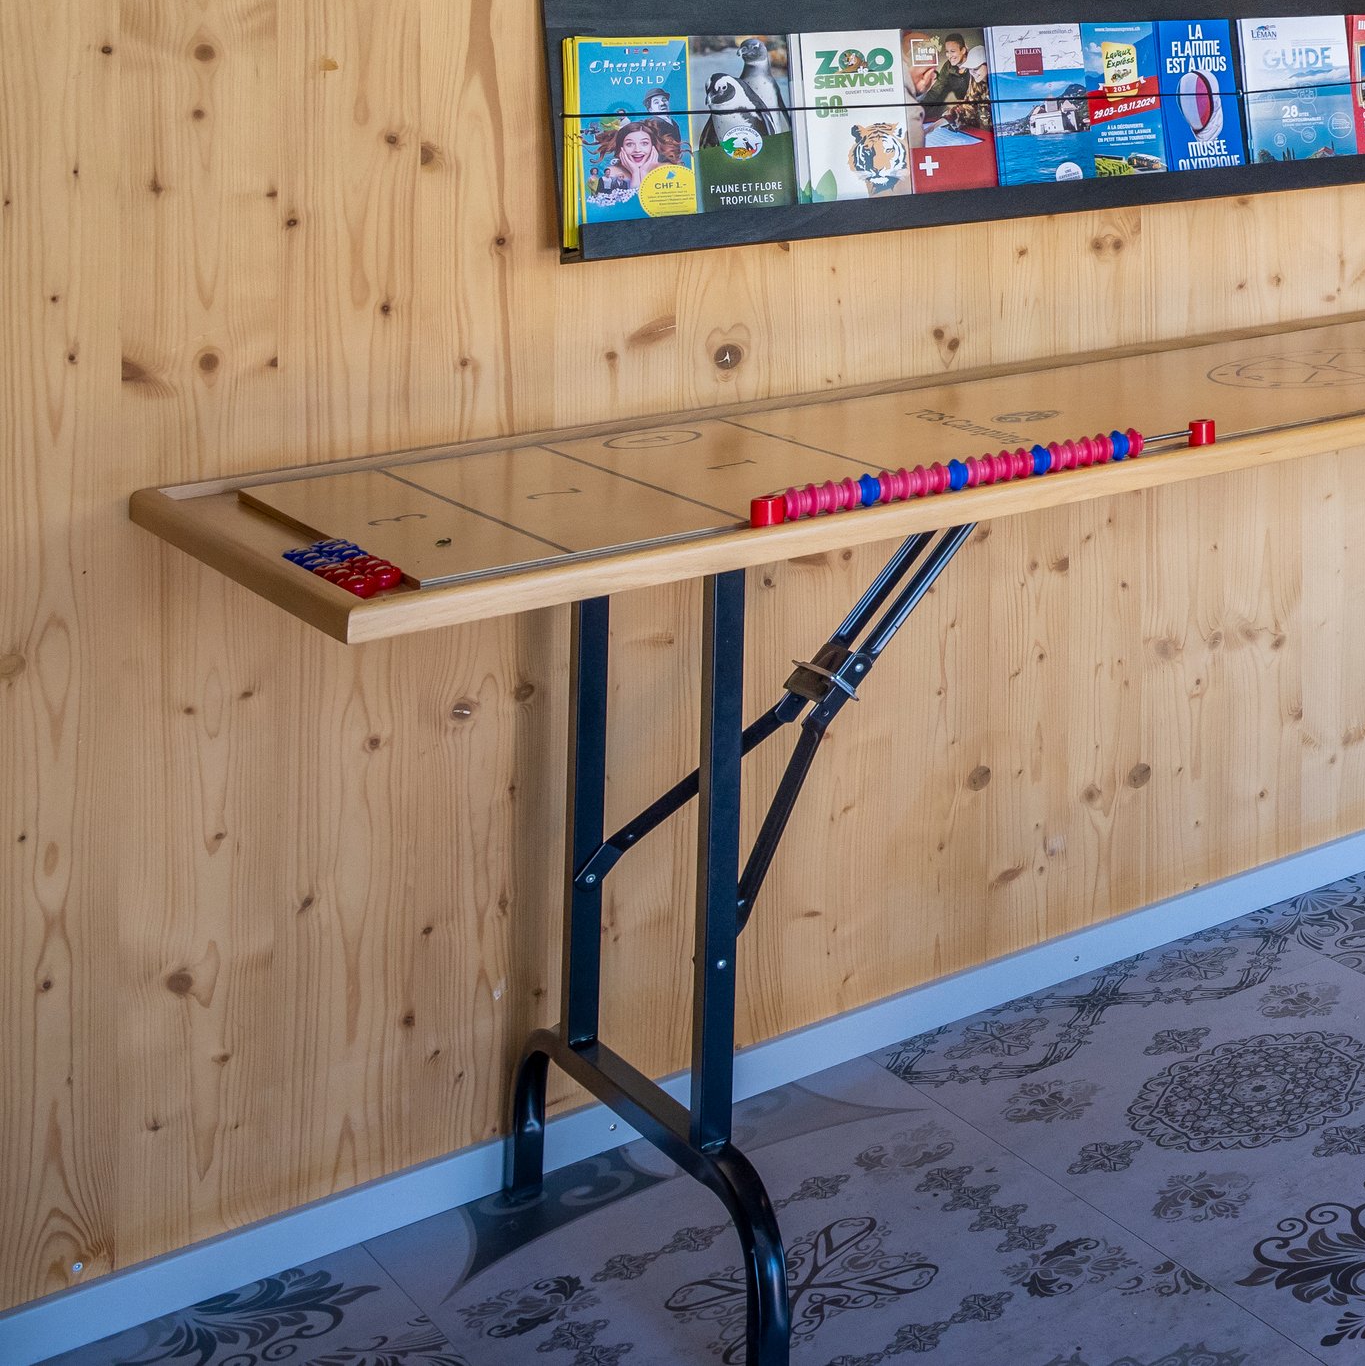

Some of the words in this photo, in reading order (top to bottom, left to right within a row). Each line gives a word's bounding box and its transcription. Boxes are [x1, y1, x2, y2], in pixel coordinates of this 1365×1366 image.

[1188, 24, 1203, 40] LA
[1251, 29, 1277, 39] LÉMAN
[1105, 49, 1132, 60] Lavaux
[1171, 40, 1221, 57] FLAMME
[815, 48, 894, 75] ZOO
[1107, 57, 1135, 69] Express
[1262, 46, 1333, 68] GUIDE
[590, 60, 681, 75] Chaplin's
[1166, 58, 1185, 74] EST
[1199, 56, 1227, 72] VOUS
[610, 76, 664, 86] WORLD
[814, 72, 893, 89] SERVION
[1113, 85, 1131, 93] 2024
[1282, 105, 1299, 118] 28
[1188, 138, 1228, 157] MUSÉE
[654, 182, 674, 190] CHF
[710, 183, 739, 194] FAUNE
[742, 183, 752, 192] ET
[755, 182, 782, 191] FLORE
[720, 194, 775, 205] TROPICALES
[368, 513, 427, 526] 3
